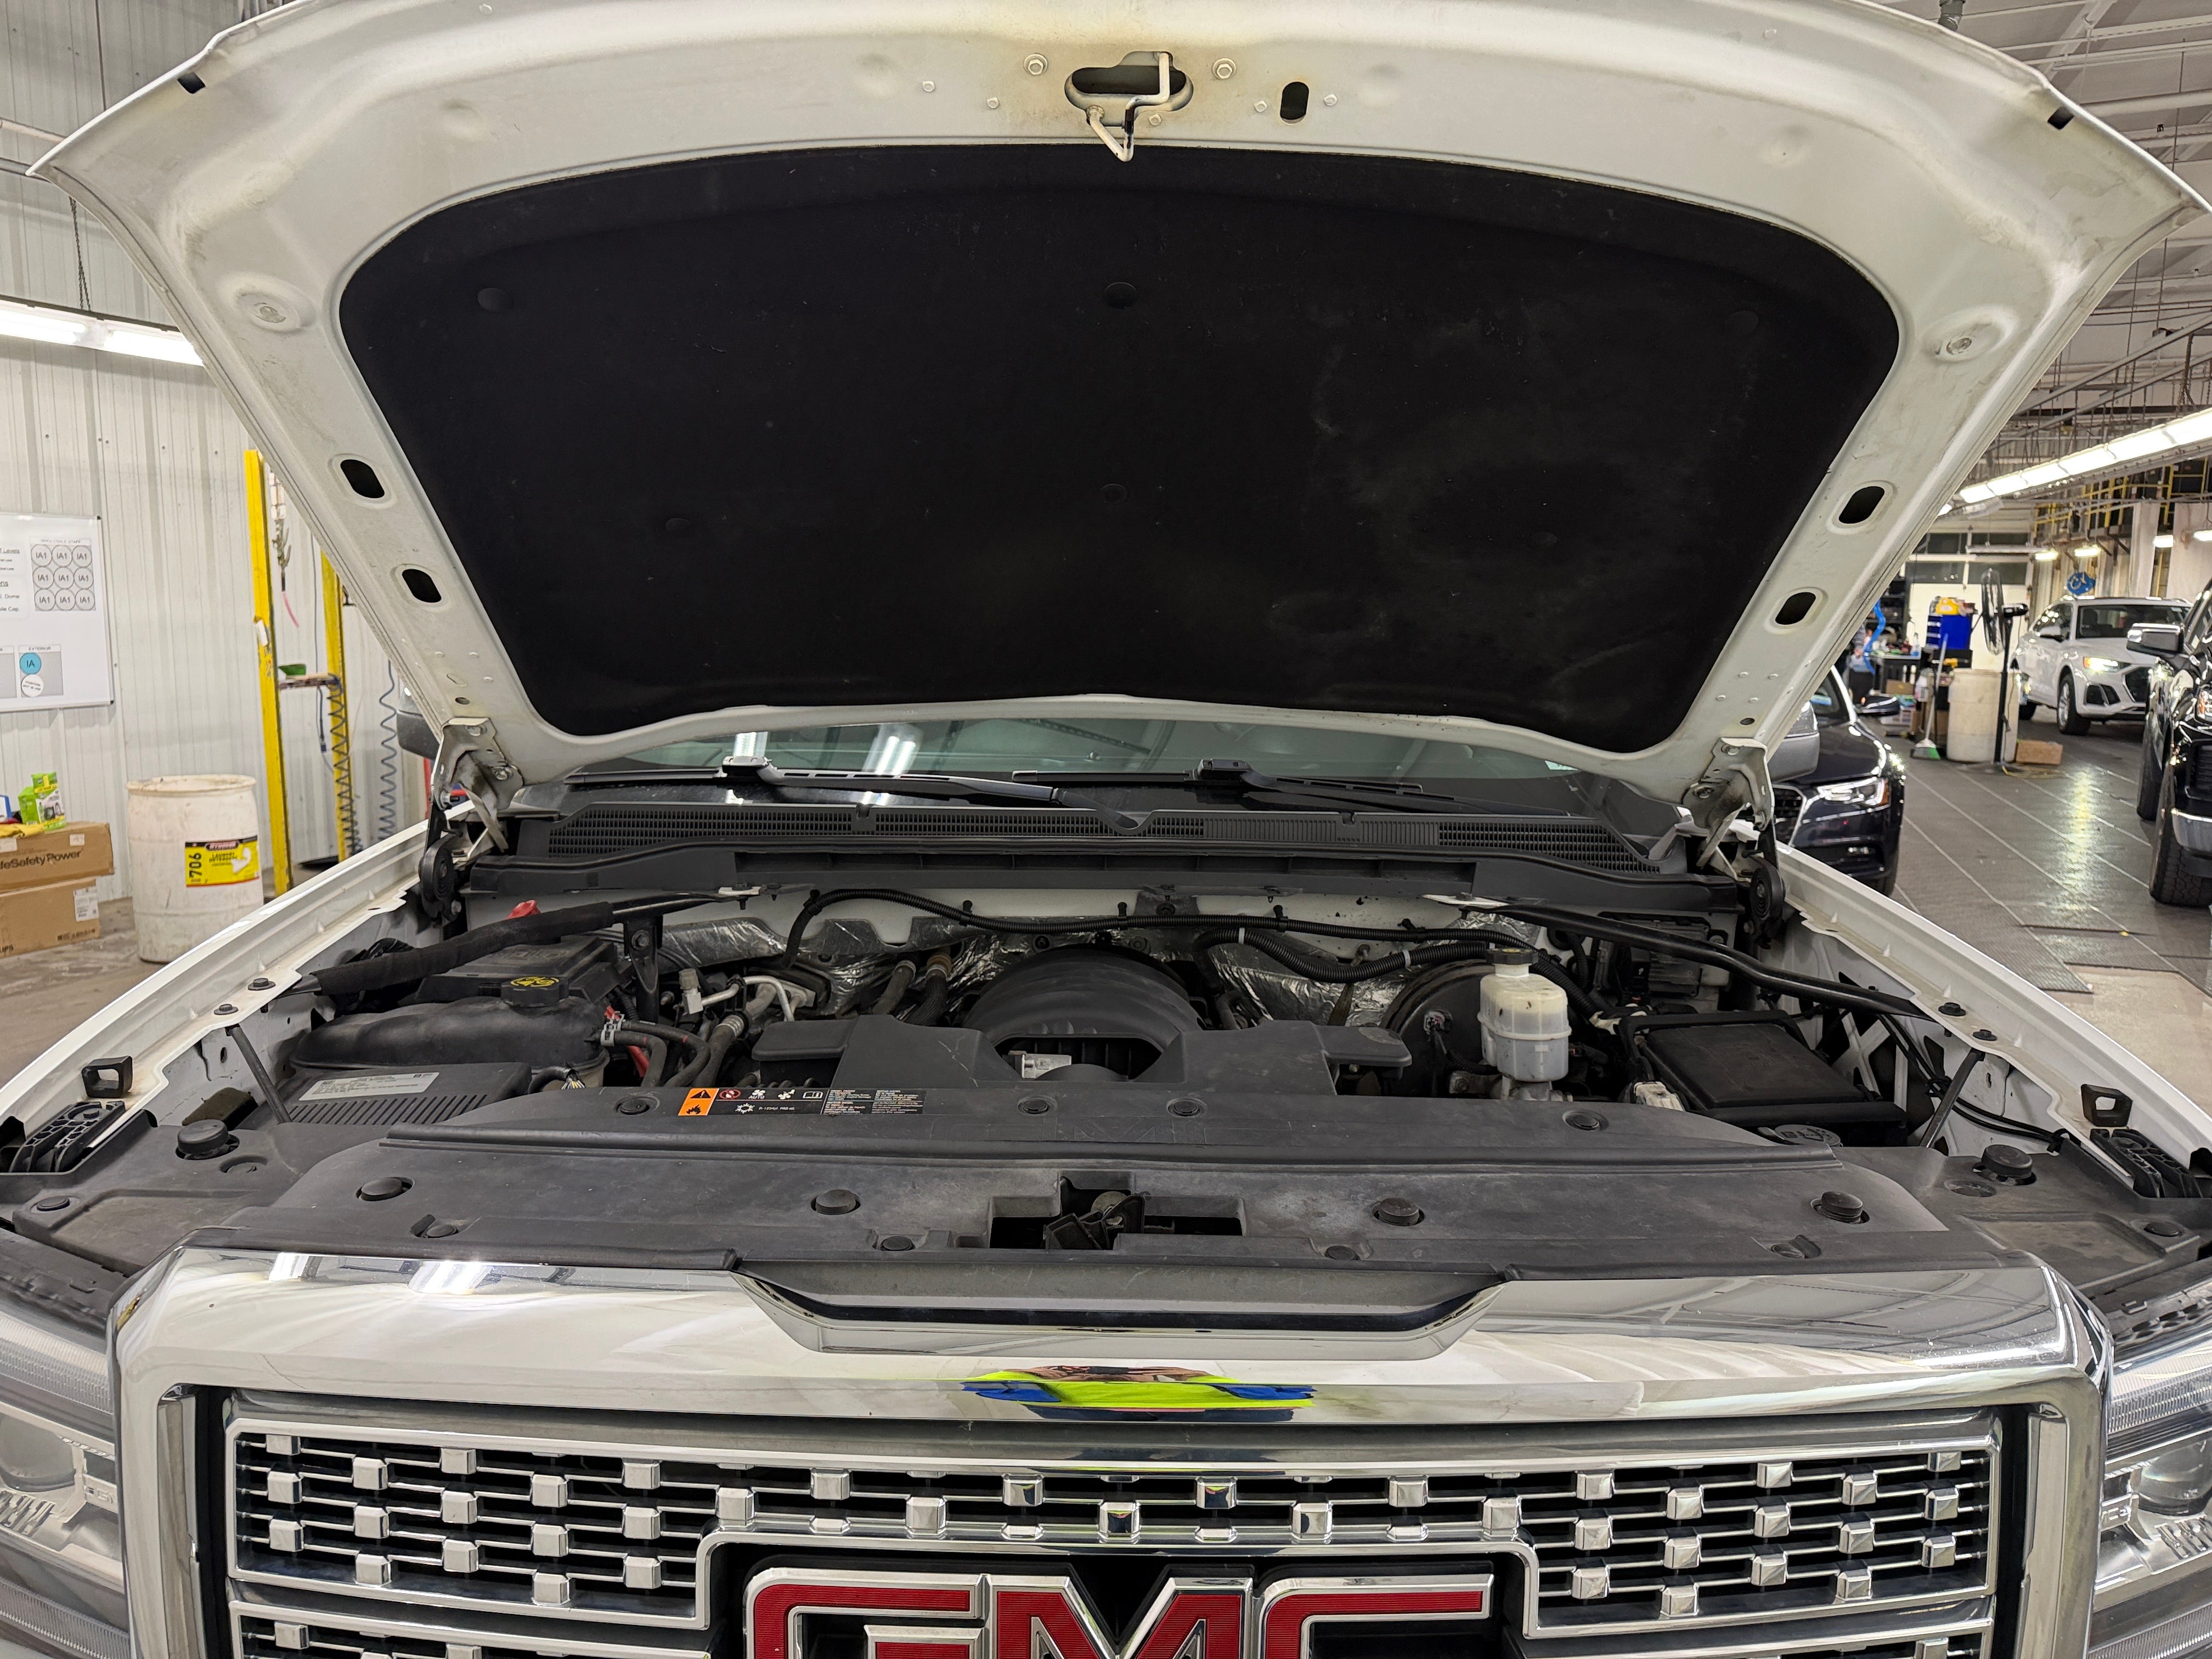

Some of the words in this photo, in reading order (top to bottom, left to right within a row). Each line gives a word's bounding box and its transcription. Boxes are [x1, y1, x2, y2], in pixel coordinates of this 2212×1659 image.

[26, 659, 35, 668] IA
[47, 851, 81, 861] Power
[188, 852, 202, 878] 706
